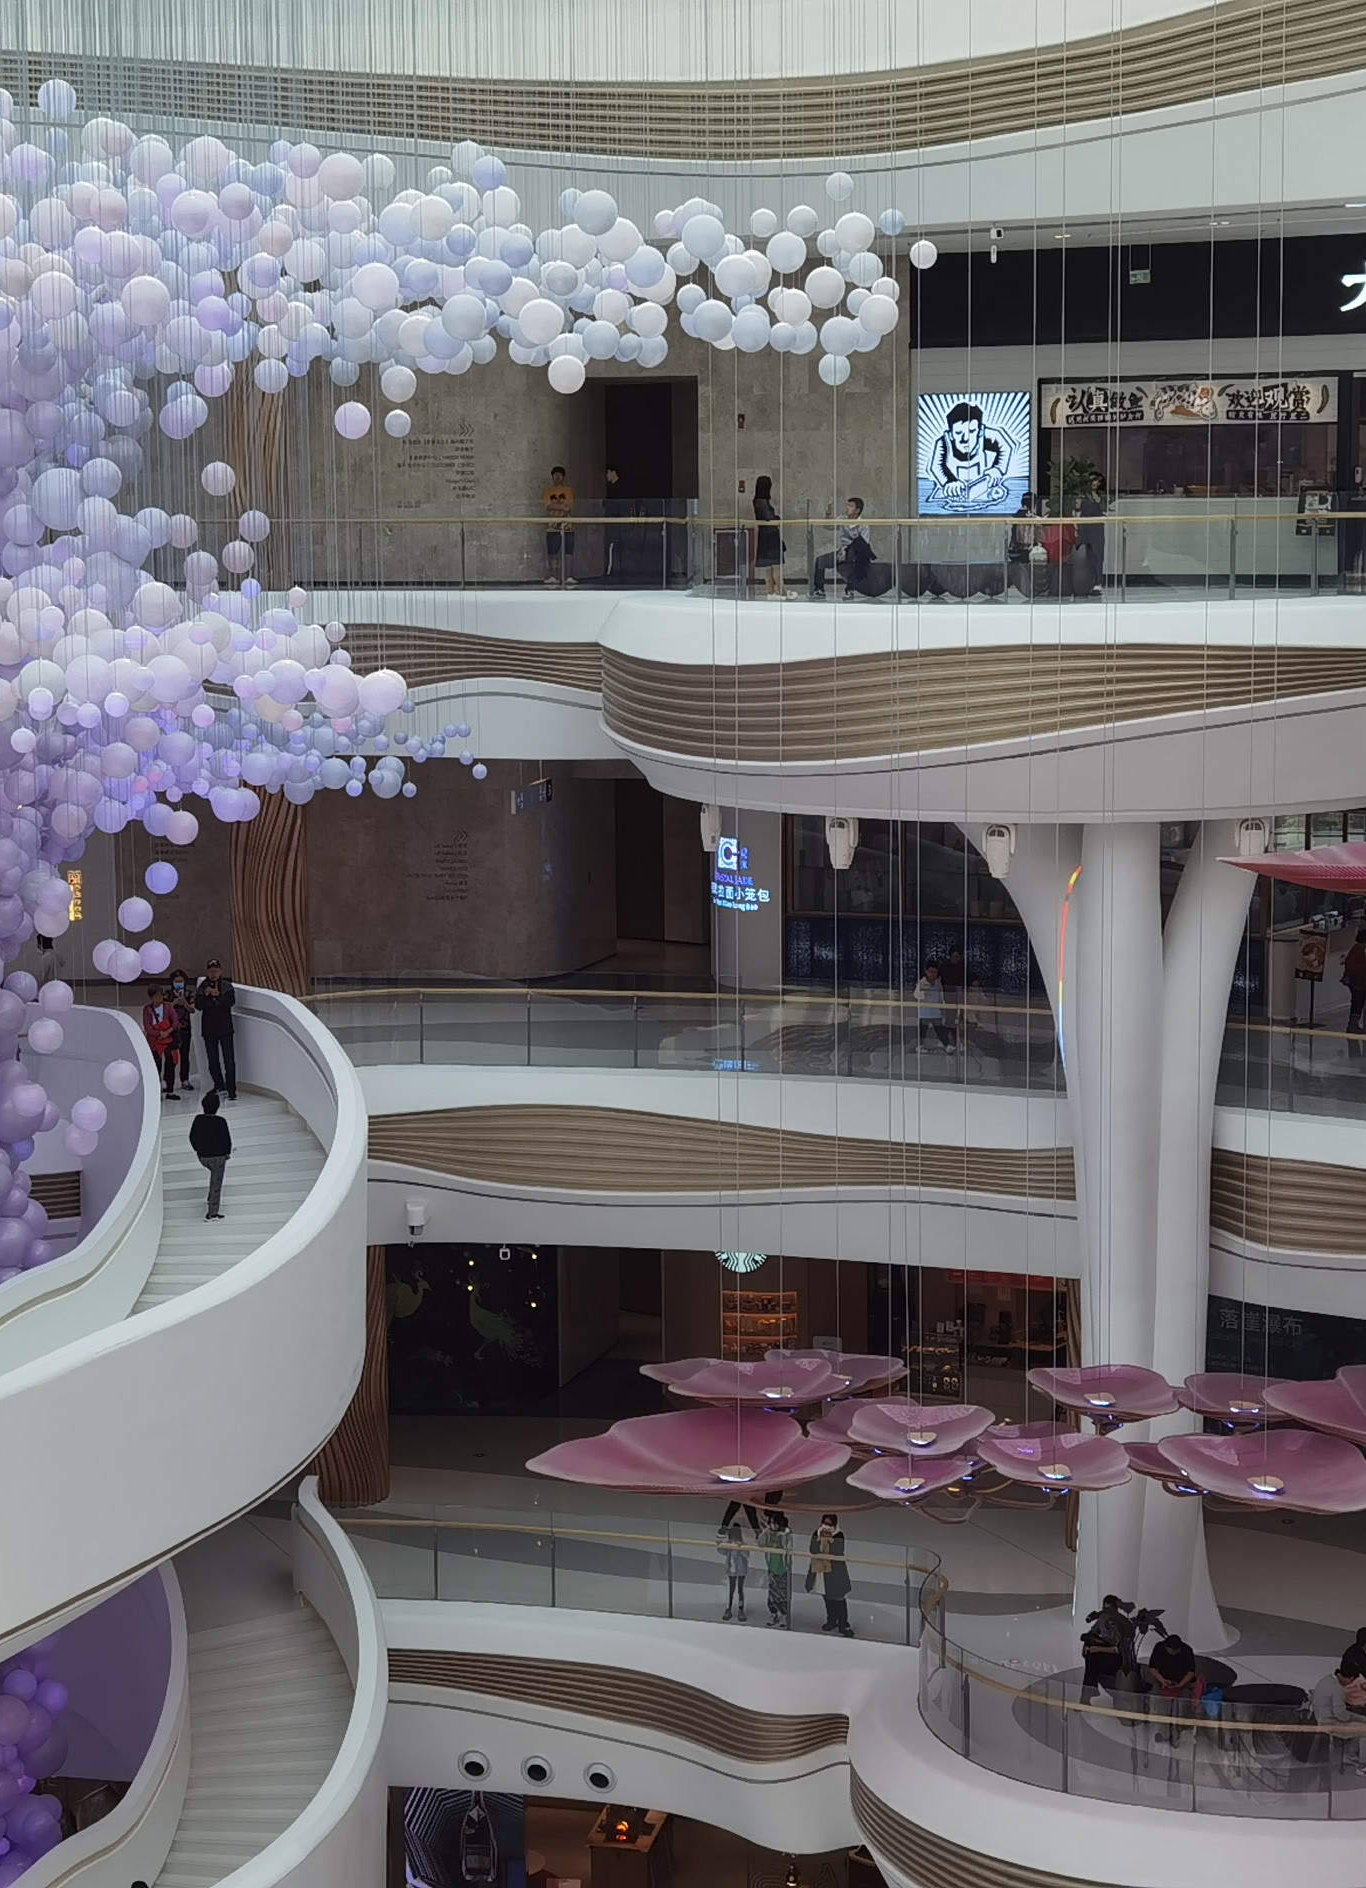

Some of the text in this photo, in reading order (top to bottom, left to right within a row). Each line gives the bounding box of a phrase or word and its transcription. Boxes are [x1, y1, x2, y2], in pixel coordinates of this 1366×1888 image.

[1065, 386, 1144, 413] 认真做鱼
[1226, 383, 1311, 411] 欢迎观赏
